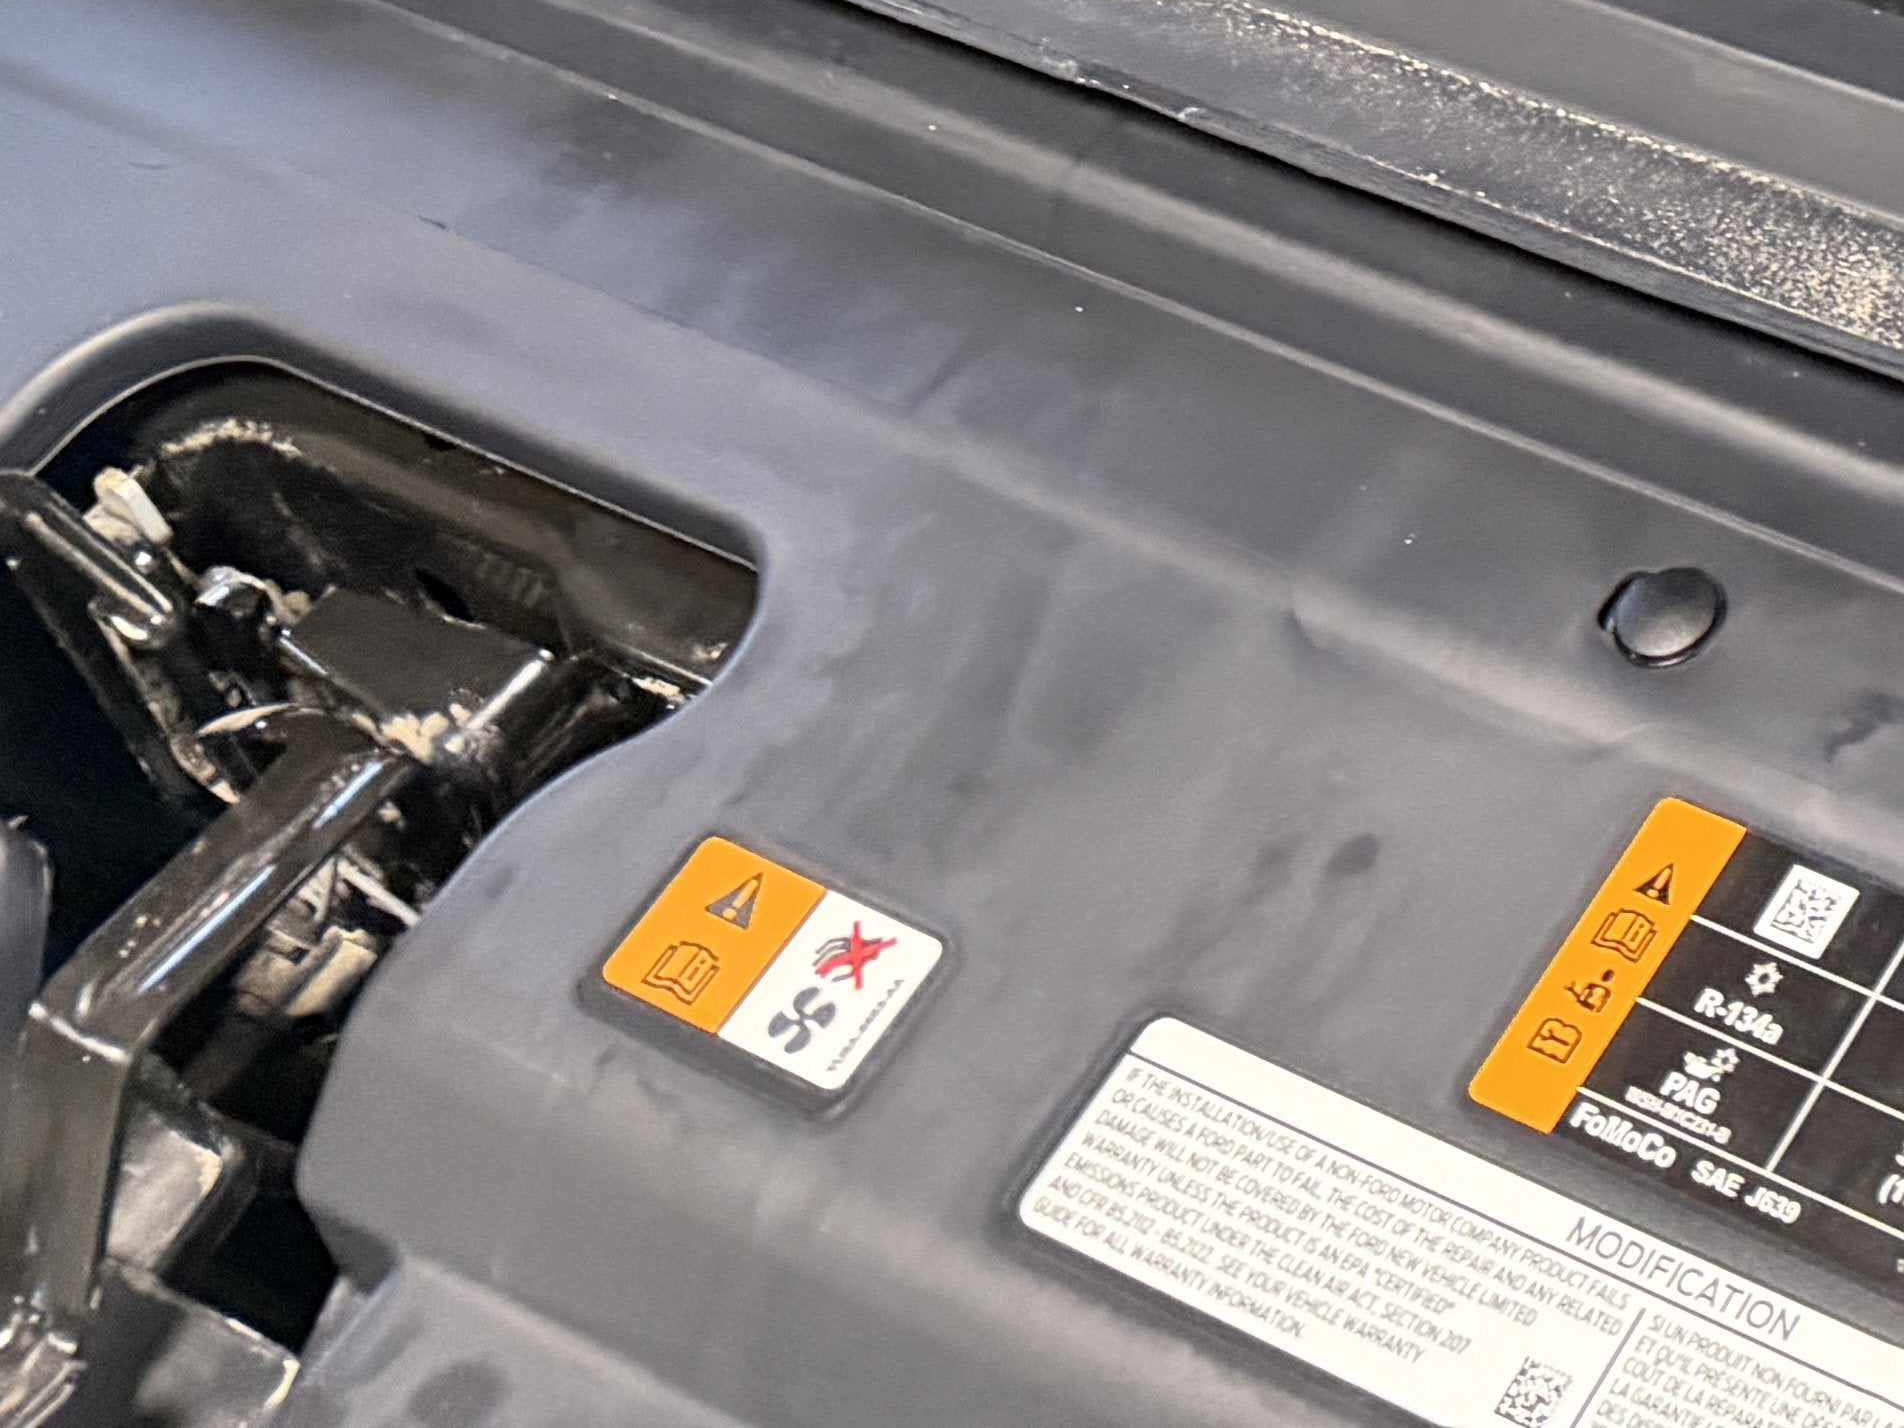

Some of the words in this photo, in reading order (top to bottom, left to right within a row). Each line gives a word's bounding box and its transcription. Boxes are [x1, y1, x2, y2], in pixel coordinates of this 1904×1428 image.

[1695, 988, 1782, 1044] R-134a
[1571, 1103, 1676, 1167] FoMoCo
[1660, 1072, 1720, 1114] PAG
[1033, 1196, 1077, 1227] GUIDE
[1074, 1215, 1105, 1238] FOR
[1102, 1231, 1129, 1254] ALL
[1130, 1246, 1206, 1289] WARRANTY
[1064, 1152, 1137, 1197] EMISSIONS
[1136, 1187, 1203, 1225] PRODUCT
[1200, 1220, 1250, 1249] UNDER
[1249, 1239, 1279, 1265] THE
[1277, 1253, 1324, 1286] CLEAN
[1321, 1275, 1349, 1296] AIR
[1380, 1302, 1441, 1341] SECTION
[1438, 1329, 1472, 1354] 207
[1081, 1133, 1157, 1175] WARRANTY
[1156, 1168, 1212, 1203] UNLESS
[1211, 1191, 1238, 1217] THE
[1238, 1205, 1306, 1244] PRODUCT
[1302, 1236, 1322, 1255] IS
[1318, 1243, 1340, 1264] AN
[1339, 1252, 1370, 1278] EPA
[1095, 1109, 1153, 1146] DAMAGE
[1153, 1139, 1186, 1163] WILL
[1185, 1151, 1219, 1174] NOT
[1215, 1165, 1236, 1185] BE
[1235, 1174, 1301, 1215] COVERED
[1297, 1203, 1321, 1223] BY
[1320, 1212, 1346, 1236] THE
[1347, 1226, 1388, 1256] FORD
[1385, 1246, 1421, 1271] NEW
[1421, 1264, 1480, 1300] VEHICLE
[1478, 1290, 1538, 1327] LIMITED
[1111, 1088, 1135, 1107] OR
[1131, 1097, 1186, 1133] CAUSES
[1183, 1122, 1198, 1137] A
[1195, 1126, 1236, 1155] FORD
[1233, 1144, 1274, 1172] PART
[1271, 1161, 1295, 1183] TO
[1326, 1186, 1357, 1212] THE
[1353, 1200, 1394, 1228] COST
[1391, 1218, 1414, 1236] OF
[1413, 1227, 1444, 1253] THE
[1442, 1242, 1494, 1274] REPAIR
[1492, 1266, 1527, 1291] AND
[1524, 1281, 1557, 1304] ANY
[1557, 1295, 1623, 1336] RELATED
[1141, 1073, 1170, 1097] THE
[1168, 1088, 1295, 1154] INSTALLATION/USE
[1294, 1144, 1317, 1162] OF
[1313, 1154, 1328, 1169] A
[1327, 1160, 1401, 1203] NON-FORD
[1398, 1193, 1453, 1226] MOTOR
[1450, 1216, 1520, 1258] COMPANY
[1520, 1248, 1589, 1289] PRODUCT
[1586, 1279, 1630, 1311] FAILS
[1691, 1160, 1744, 1197] SAE
[1744, 1187, 1801, 1223] J639
[1048, 1175, 1082, 1199] AND
[1078, 1188, 1108, 1211] CFR
[1216, 1254, 1246, 1278] SEE
[1245, 1271, 1287, 1296] YOUR
[1285, 1289, 1343, 1325] VEHICLE
[1343, 1316, 1423, 1362] WARRANTY
[1566, 1215, 1801, 1342] MODIFICATION
